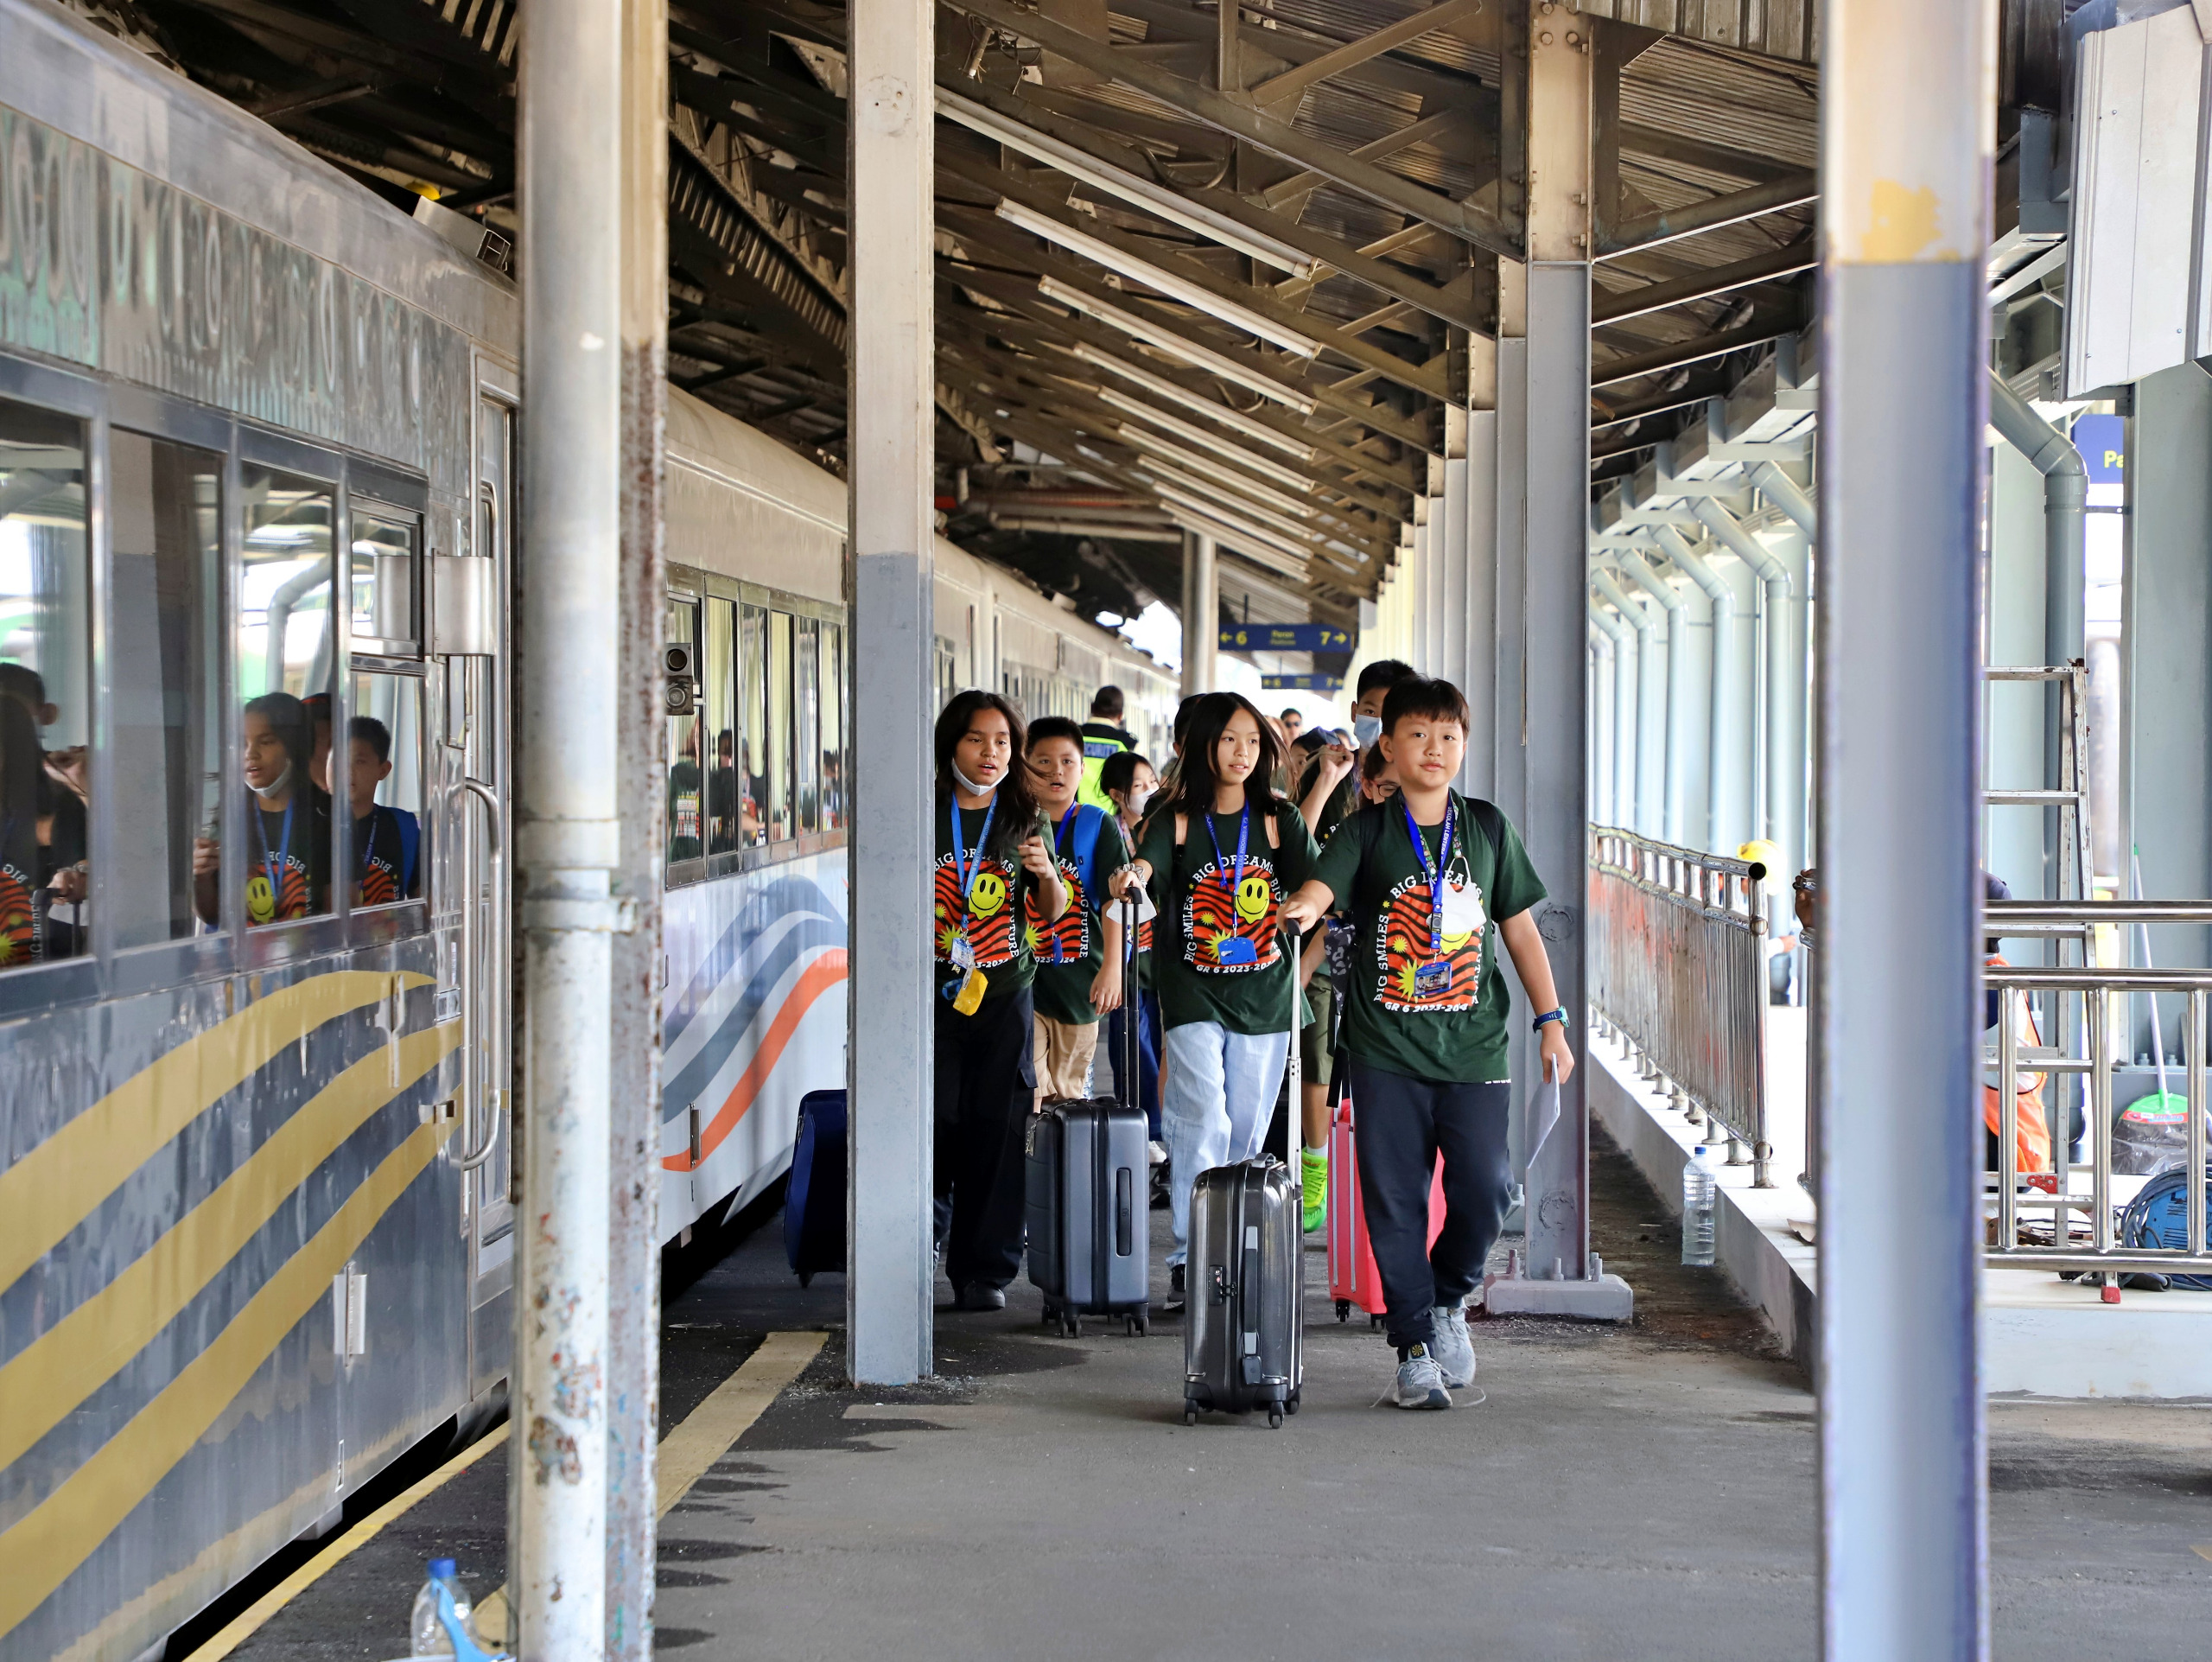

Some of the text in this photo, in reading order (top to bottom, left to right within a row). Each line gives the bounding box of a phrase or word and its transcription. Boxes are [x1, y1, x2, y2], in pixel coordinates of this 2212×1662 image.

[1236, 631, 1247, 646] 6
[1320, 632, 1331, 646] 7
[1084, 743, 1117, 758] CURITY
[934, 848, 1014, 873] BIG DRMS
[1056, 855, 1079, 879] AMS
[1192, 855, 1274, 883] BIG DREAMS
[1390, 875, 1417, 900] BIG
[1421, 869, 1483, 899] EAS
[1079, 911, 1089, 958] FUTURE
[1183, 895, 1198, 963] BIG SMILES
[1196, 965, 1210, 973] GR
[1223, 960, 1277, 974] 2023-202
[1374, 914, 1389, 1003] BIG SMILES
[1385, 1002, 1469, 1013] GR 6 2023-204
